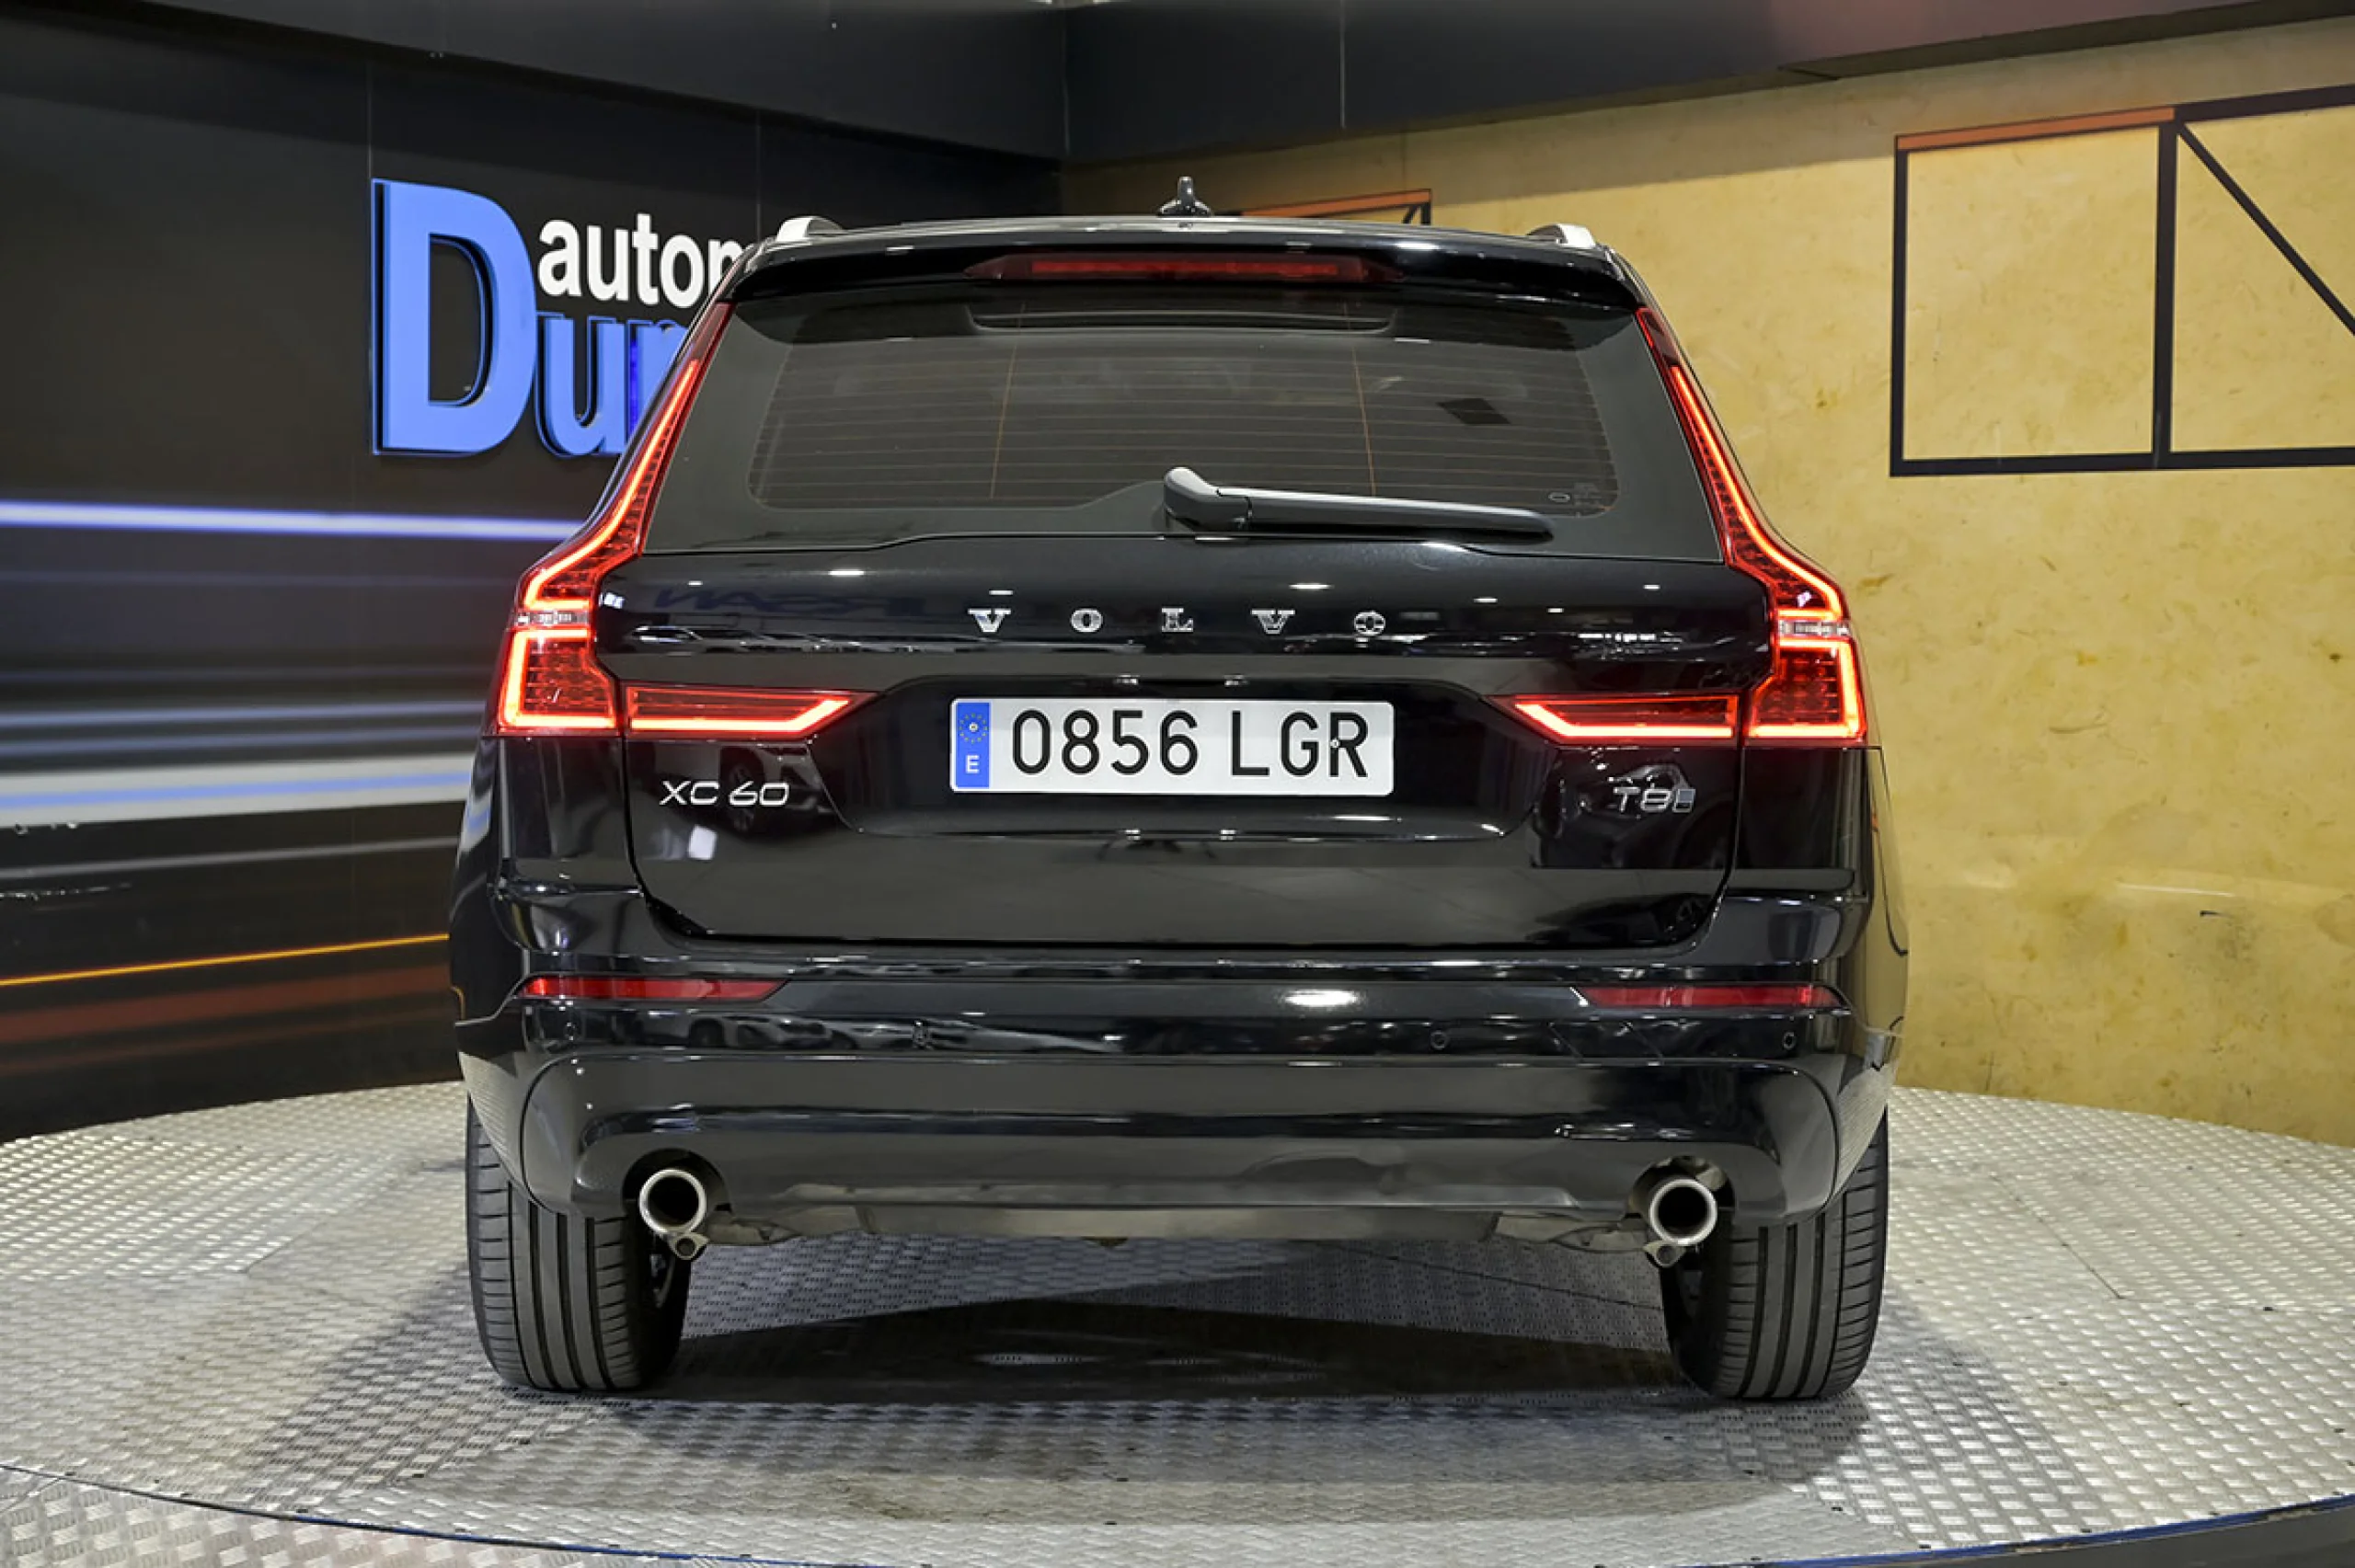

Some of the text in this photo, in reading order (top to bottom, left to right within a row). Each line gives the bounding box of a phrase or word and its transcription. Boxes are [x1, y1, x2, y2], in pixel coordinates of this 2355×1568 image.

[968, 608, 1386, 636] VOLVO
[1012, 709, 1369, 778] 0856 LGR
[965, 754, 980, 774] E
